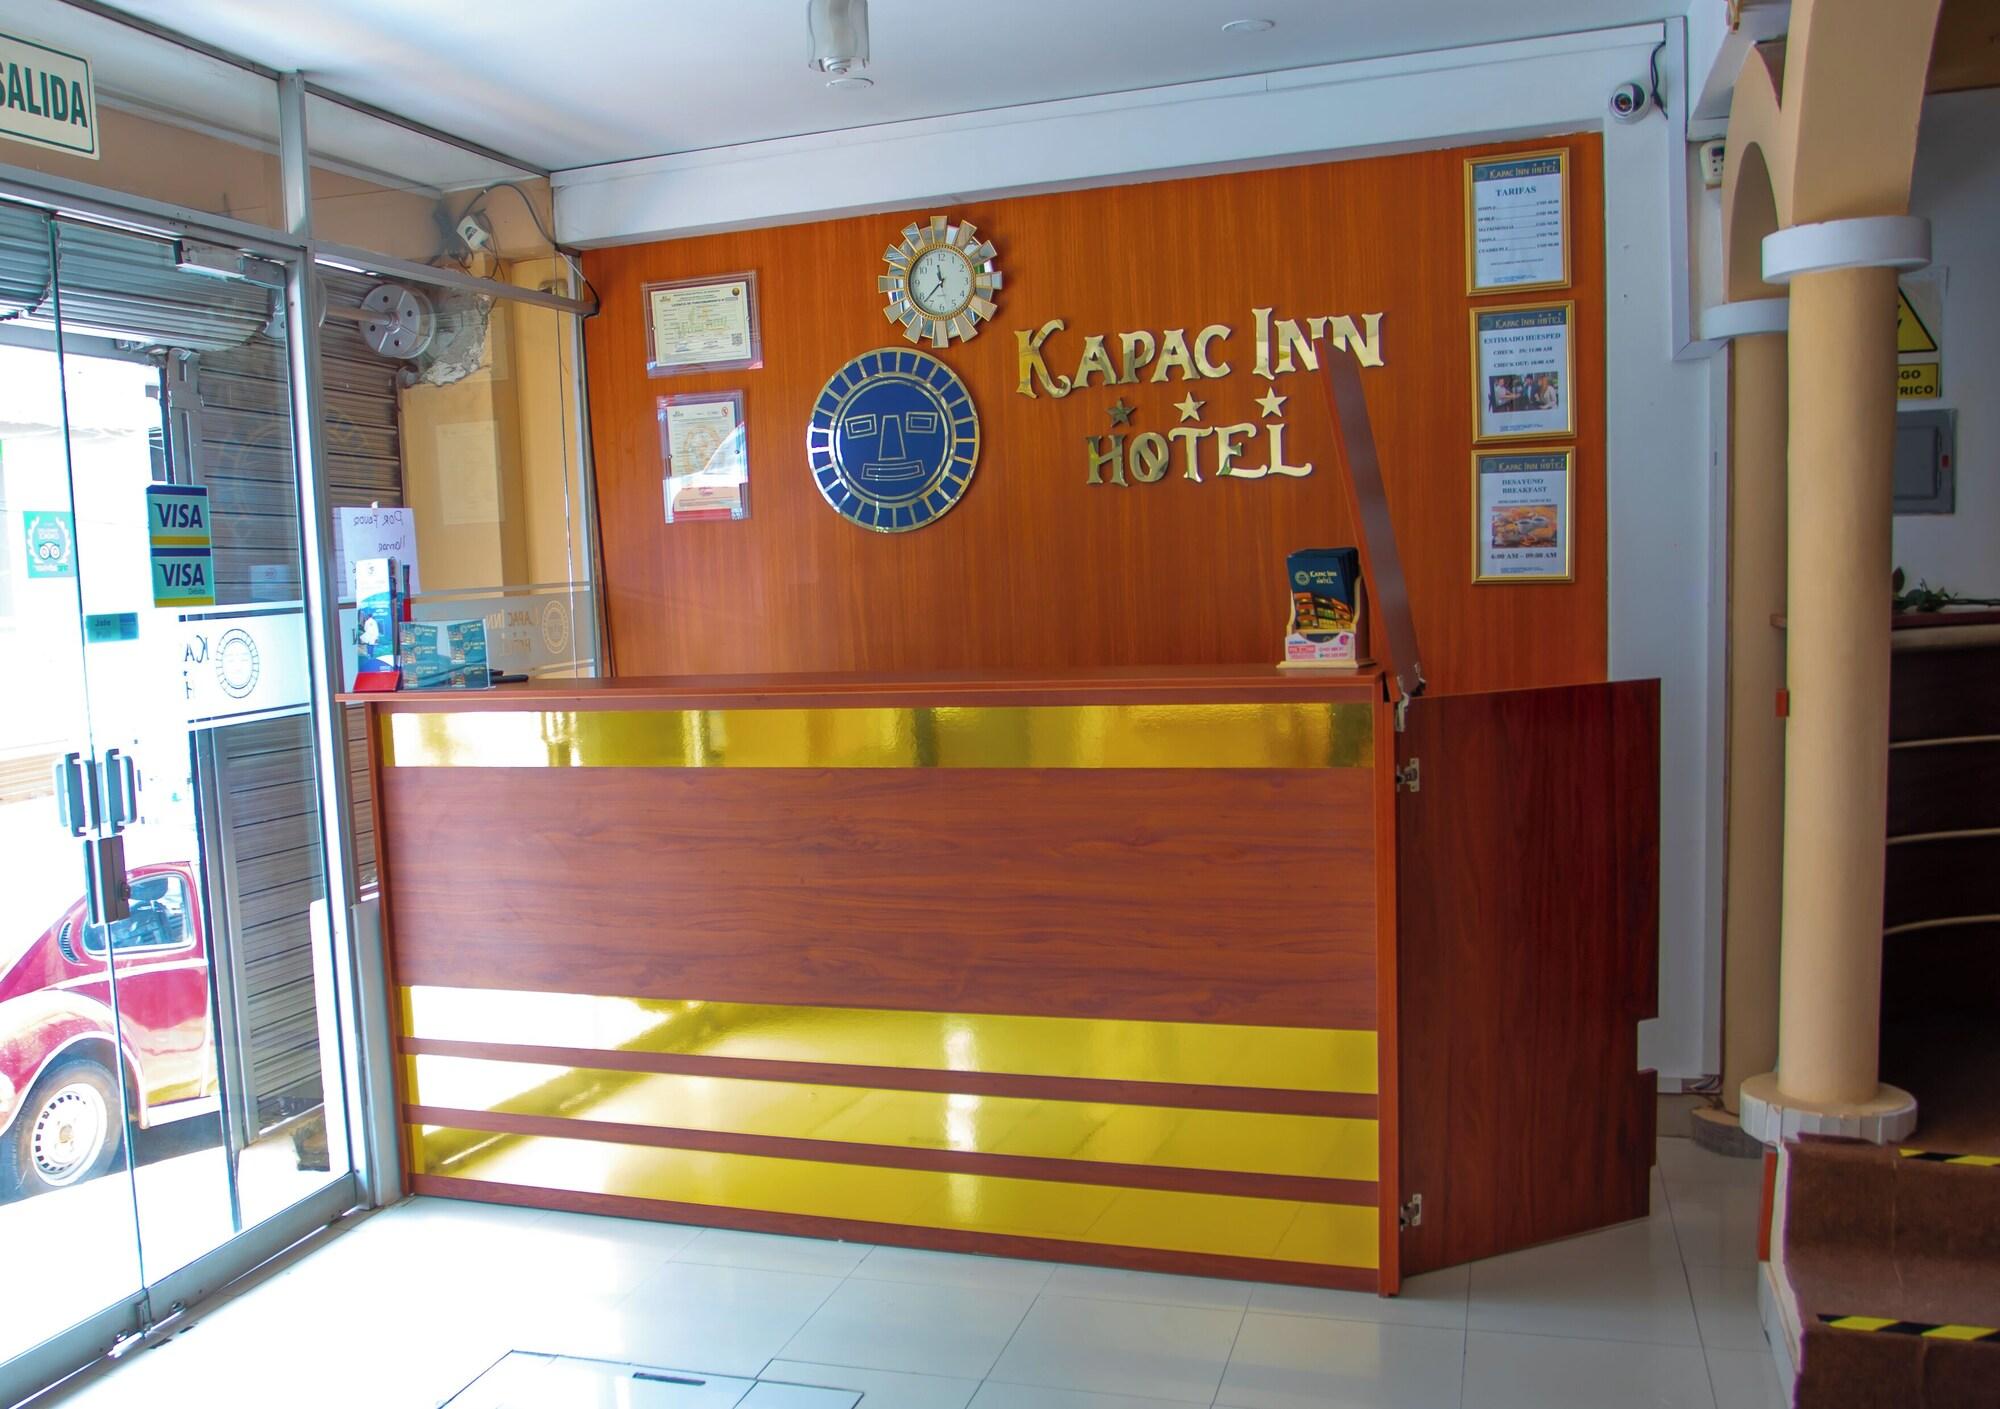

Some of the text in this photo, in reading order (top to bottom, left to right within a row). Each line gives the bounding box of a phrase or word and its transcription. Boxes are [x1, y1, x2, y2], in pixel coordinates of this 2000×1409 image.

[1496, 185, 1536, 196] TARIFAS
[1013, 306, 1385, 399] KAPAC INN
[1896, 369, 1921, 380] GO
[1086, 422, 1312, 487] HOTEL
[1502, 486, 1547, 494] BREAKFAST
[153, 502, 203, 528] VISA
[157, 562, 205, 586] VISA
